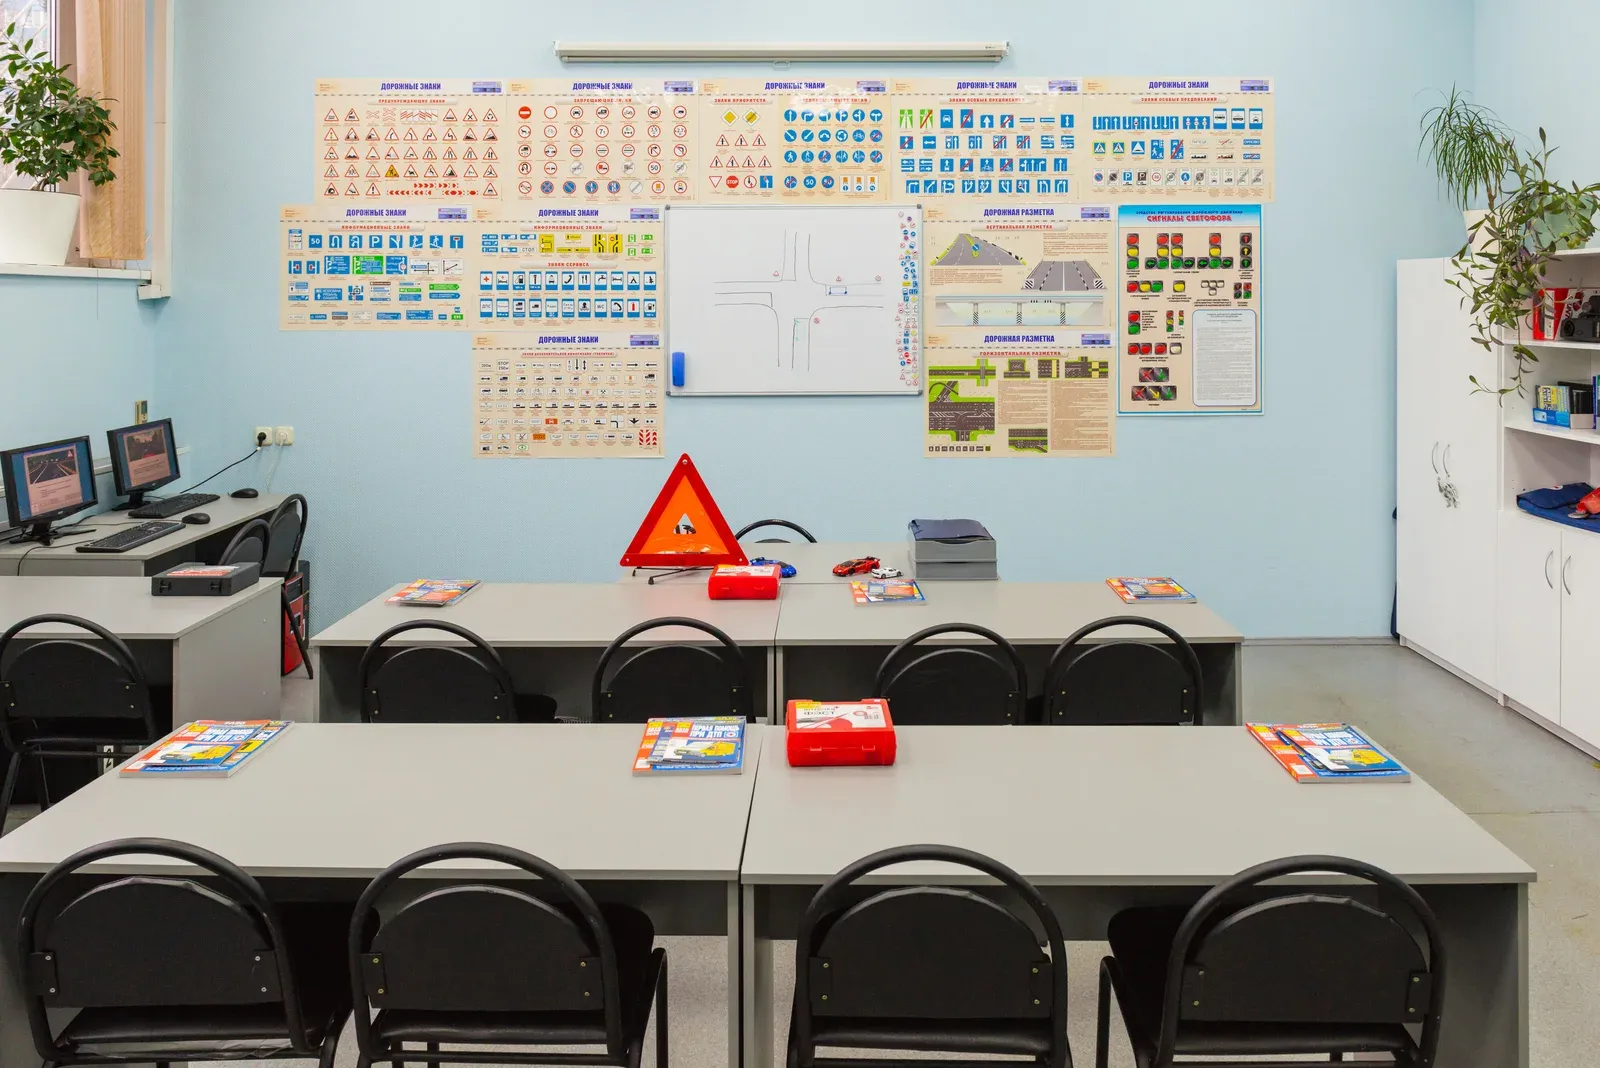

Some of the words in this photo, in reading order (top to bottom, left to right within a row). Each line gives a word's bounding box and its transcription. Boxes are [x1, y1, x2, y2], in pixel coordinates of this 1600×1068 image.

[380, 82, 419, 90] ДОРОЖНЫЕ
[572, 82, 611, 90] ДОРОЖНЫЕ
[764, 82, 803, 90] ДОРОЖНЫЕ
[956, 82, 994, 90] ДОРОЖНЫЕ
[1148, 81, 1187, 89] ДОРОЖНЫЕ
[984, 208, 1020, 216] ДОРОЖНАЯ
